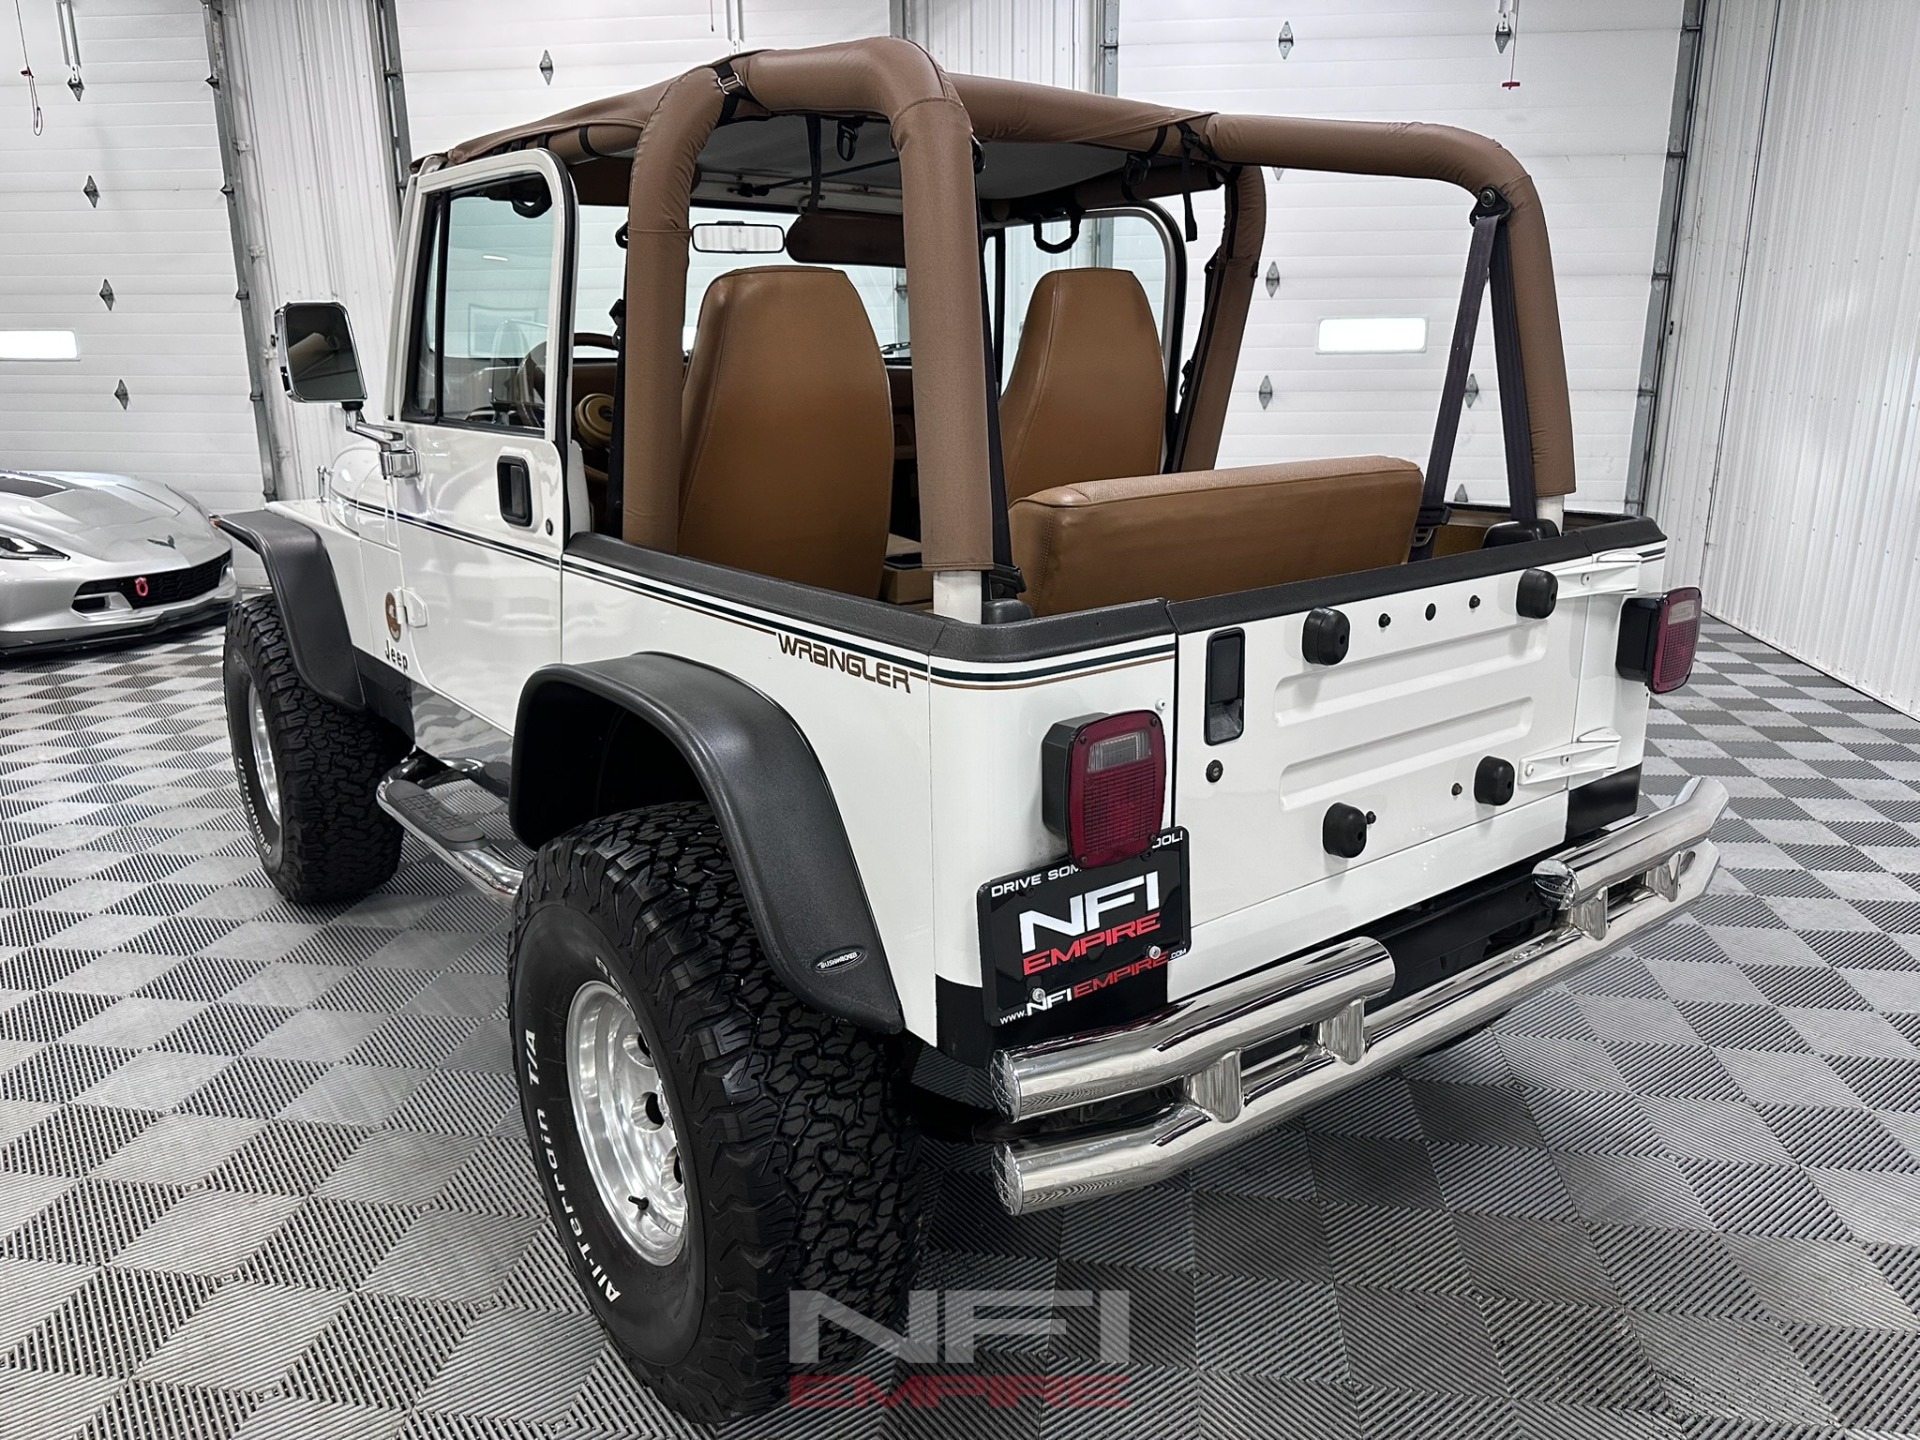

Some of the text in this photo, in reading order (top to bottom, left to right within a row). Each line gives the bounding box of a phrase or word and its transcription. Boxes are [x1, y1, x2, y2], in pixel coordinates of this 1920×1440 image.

[385, 639, 408, 673] Jeep
[991, 830, 1184, 898] DRIVE SOM OOL!
[1019, 871, 1160, 954] NFI
[1022, 912, 1161, 976] EMPIRE
[525, 1028, 540, 1086] T/A
